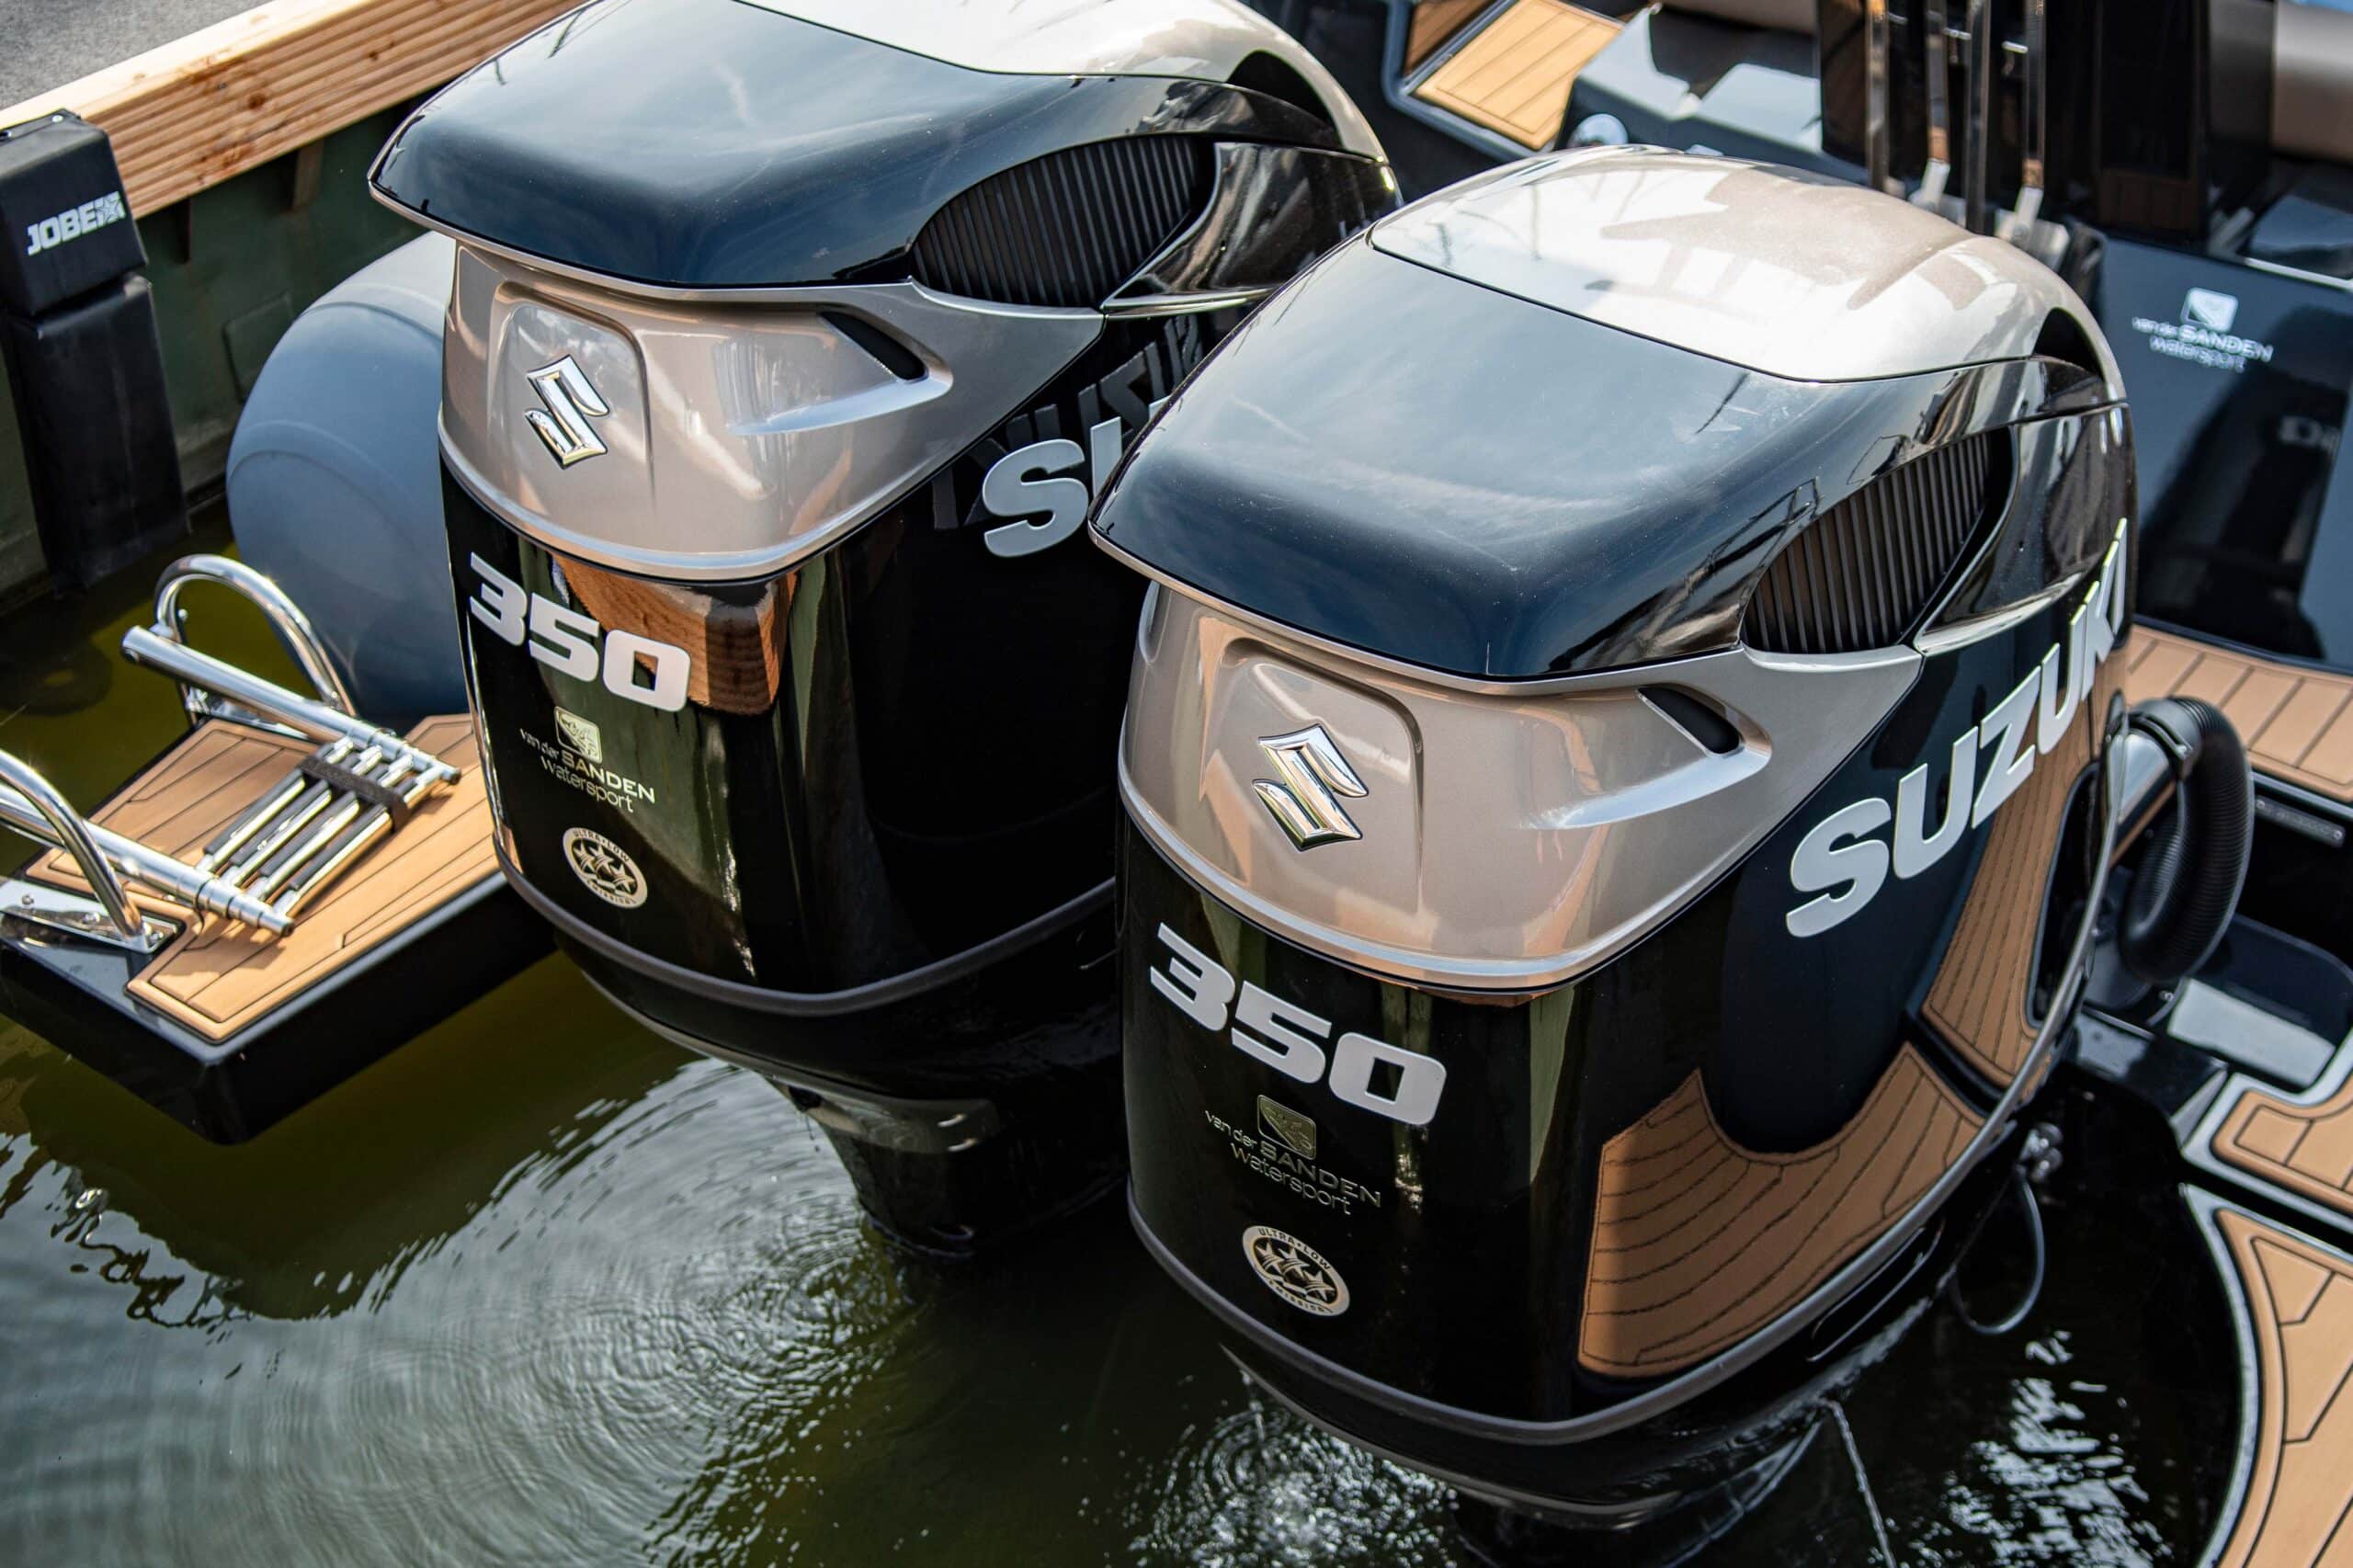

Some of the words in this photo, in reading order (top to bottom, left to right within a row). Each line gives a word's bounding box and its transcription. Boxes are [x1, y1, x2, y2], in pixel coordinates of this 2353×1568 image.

[2177, 324, 2274, 362] SANDEN
[470, 551, 691, 712] 350
[1786, 517, 2128, 937] SUZUKI
[540, 755, 634, 813] Watersport
[562, 749, 655, 804] SANDEN
[1149, 922, 1448, 1126] 350
[1204, 1110, 1232, 1136] van
[1232, 1129, 1258, 1150] der
[1260, 1140, 1381, 1208] SANDEN
[1230, 1142, 1351, 1215] Watersport
